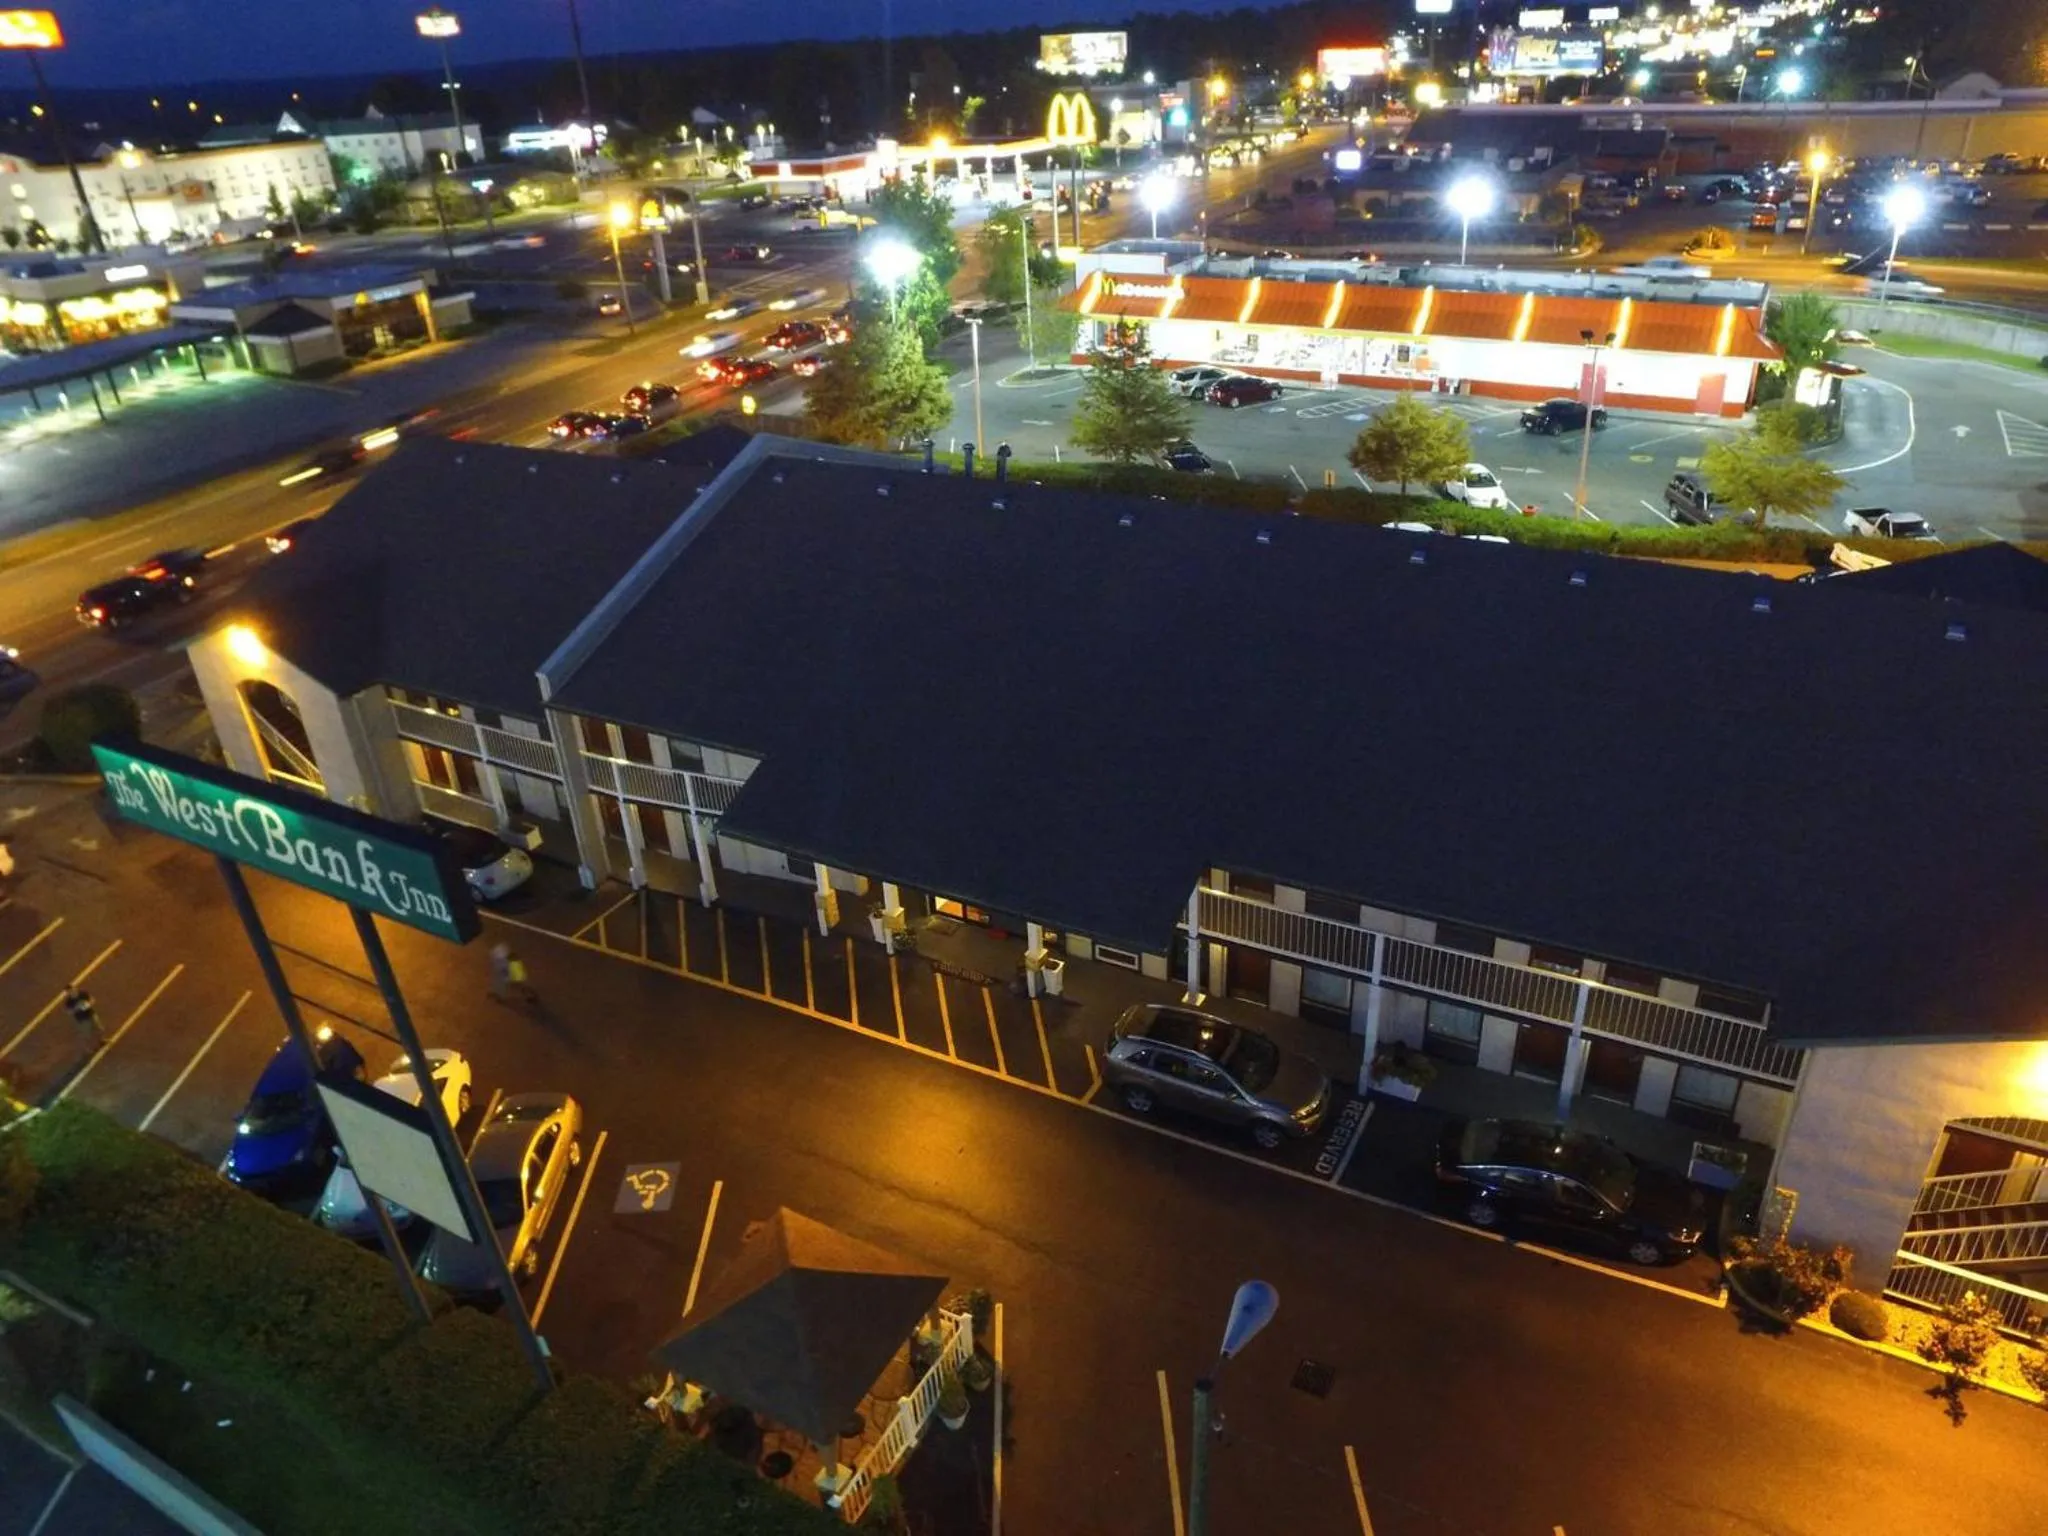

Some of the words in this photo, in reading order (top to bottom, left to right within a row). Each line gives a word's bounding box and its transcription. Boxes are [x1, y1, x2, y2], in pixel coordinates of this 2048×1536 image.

[105, 769, 149, 813] The
[130, 762, 240, 846] West
[234, 798, 408, 916] Bank
[388, 873, 453, 924] Inn
[1316, 1100, 1364, 1173] RESERVED
